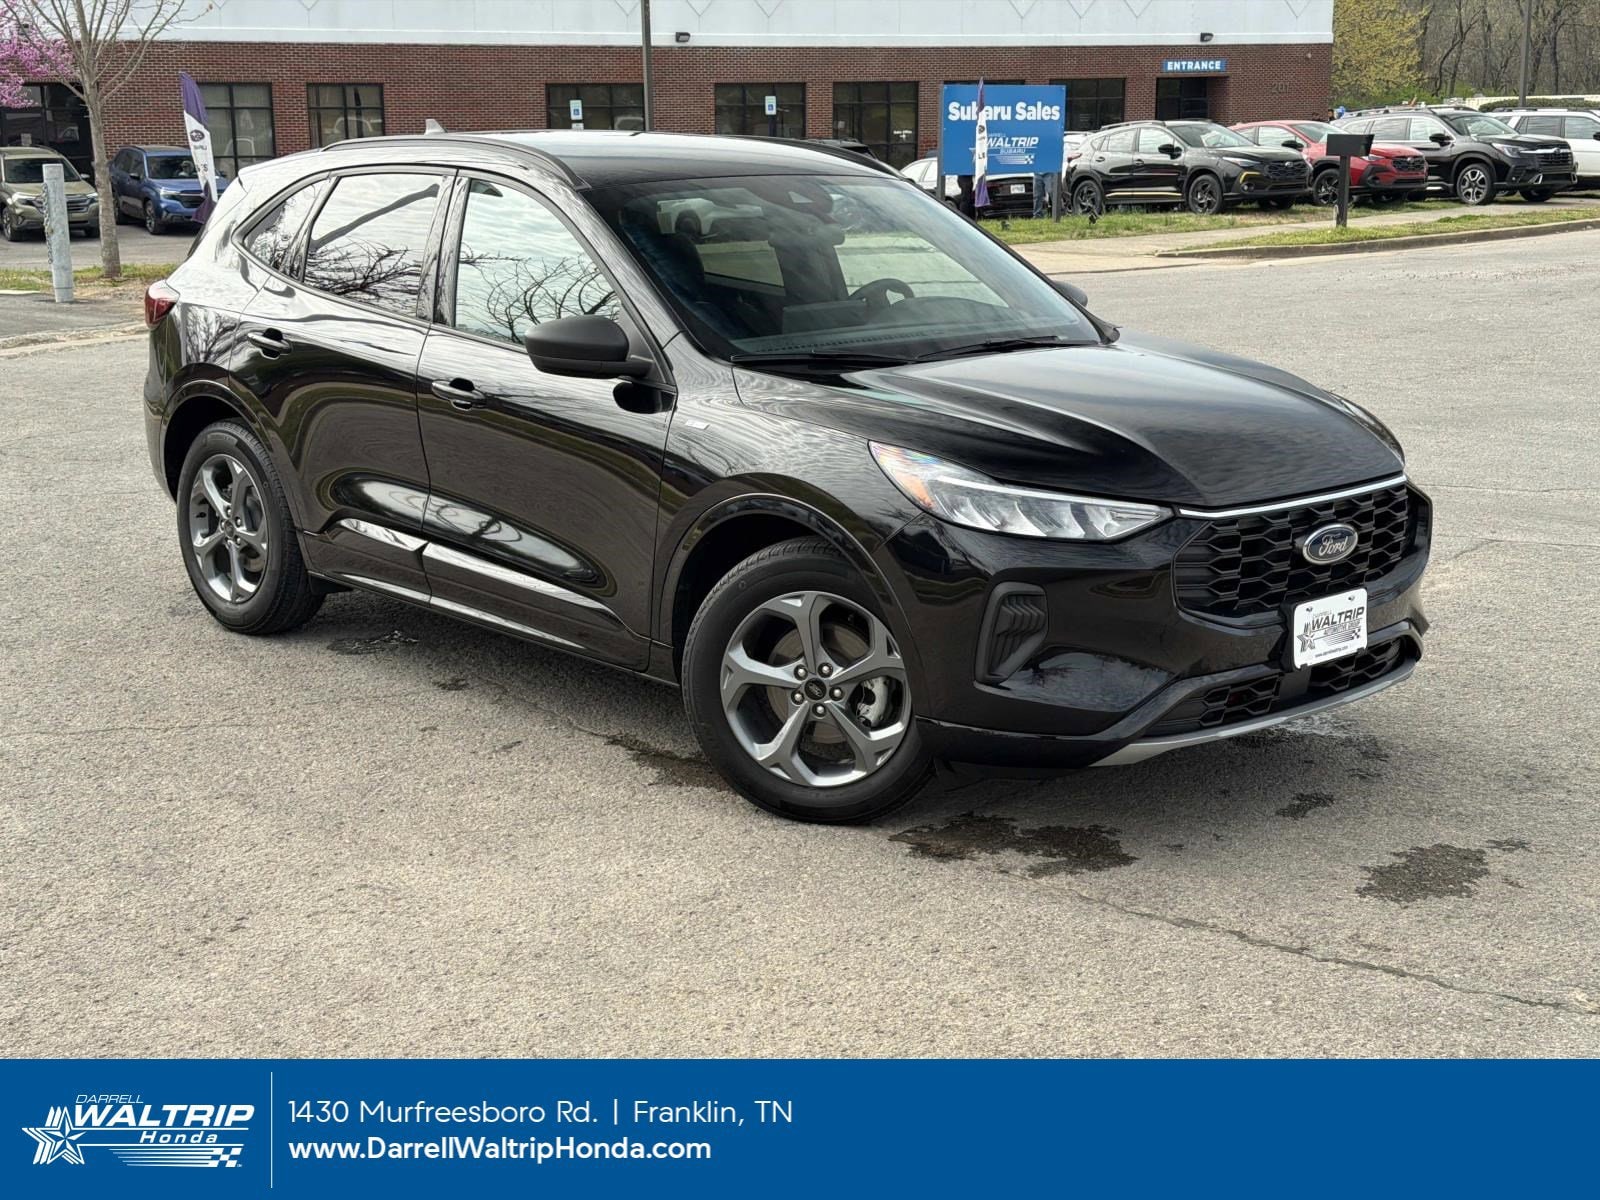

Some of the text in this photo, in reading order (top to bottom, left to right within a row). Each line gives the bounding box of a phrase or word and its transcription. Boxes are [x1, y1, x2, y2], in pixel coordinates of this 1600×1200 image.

[1167, 60, 1221, 71] ENTRANCE
[1015, 101, 1061, 121] Sales
[985, 136, 1039, 147] WALTRIP
[1318, 532, 1349, 557] Ford
[1312, 606, 1365, 631] WALTRIP
